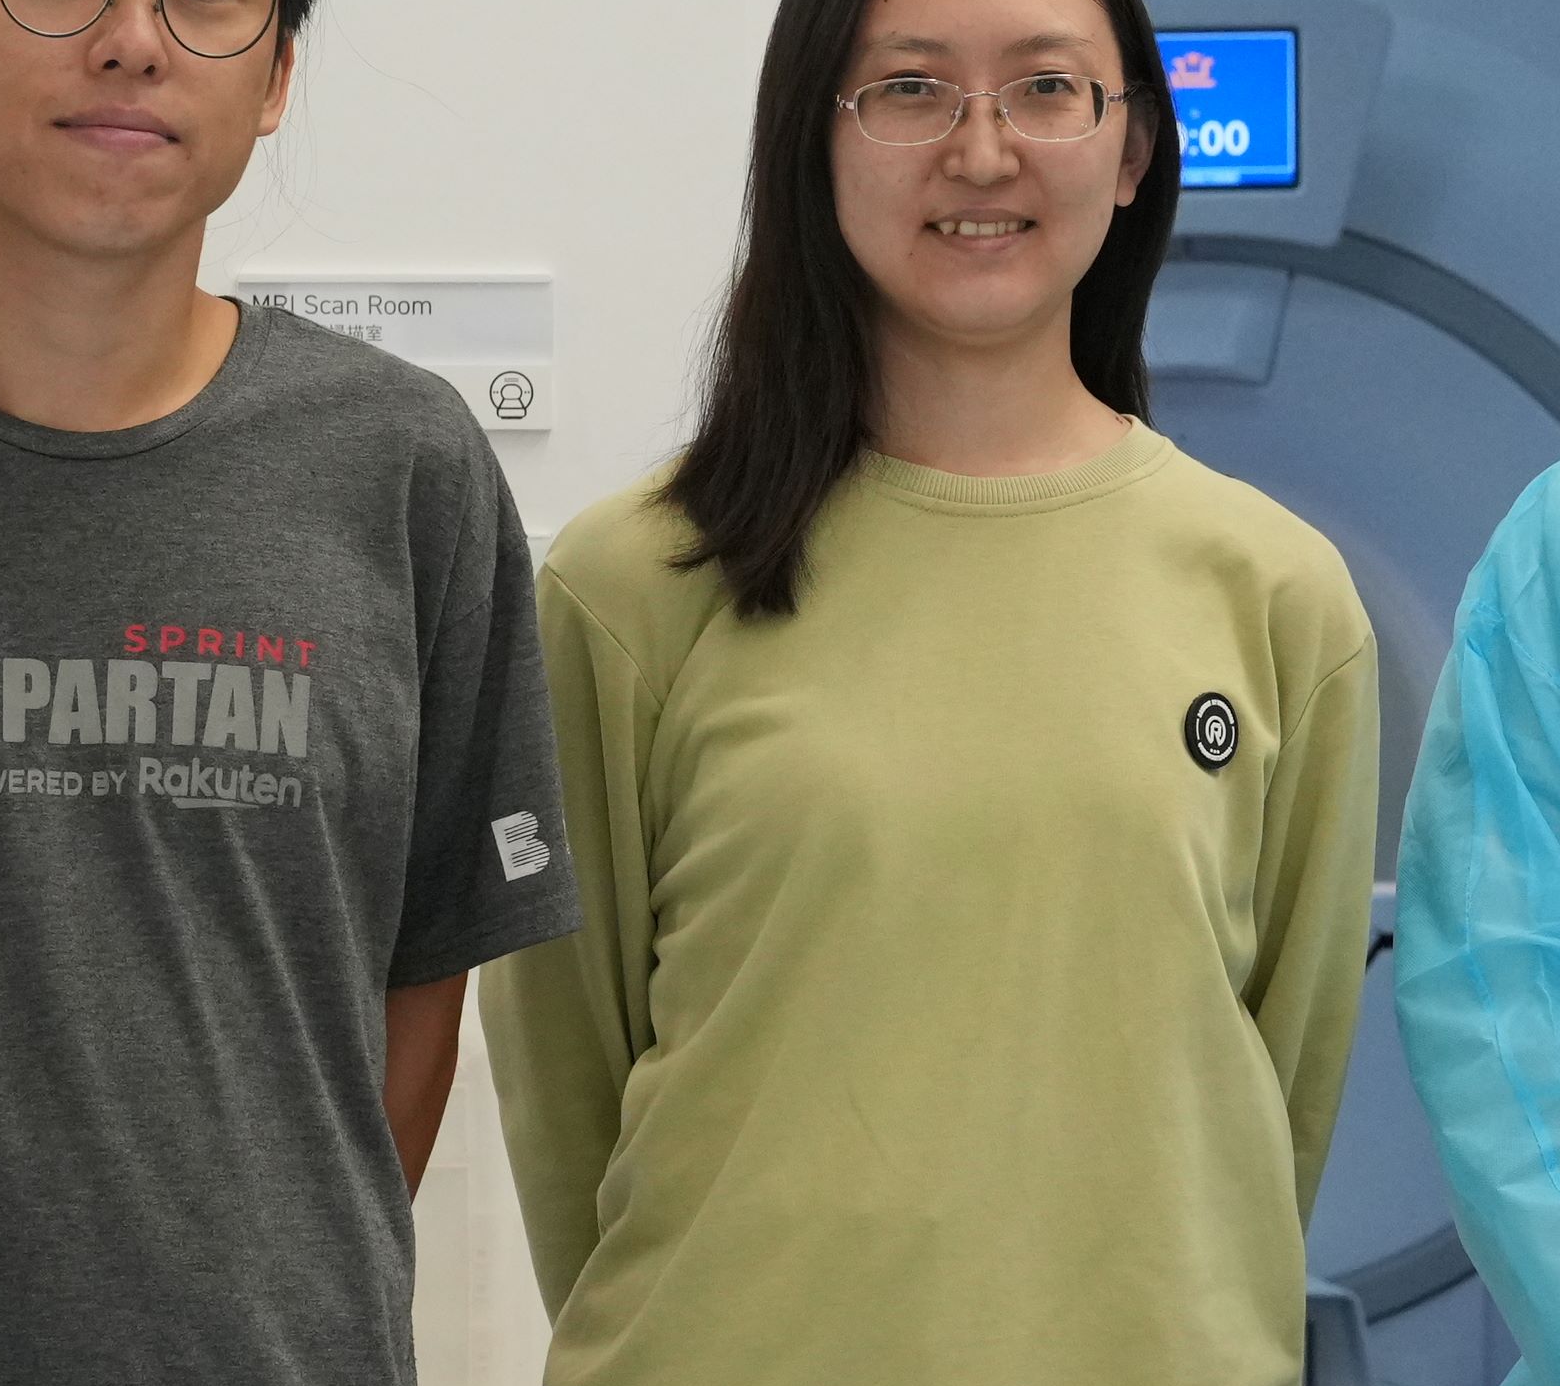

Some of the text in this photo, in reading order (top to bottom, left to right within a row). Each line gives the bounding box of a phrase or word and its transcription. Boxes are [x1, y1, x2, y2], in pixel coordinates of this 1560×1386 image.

[252, 294, 432, 315] MRI Scan Room
[124, 624, 317, 669] SPRINT
[92, 770, 127, 796] BY
[139, 757, 302, 808] Rakuten
